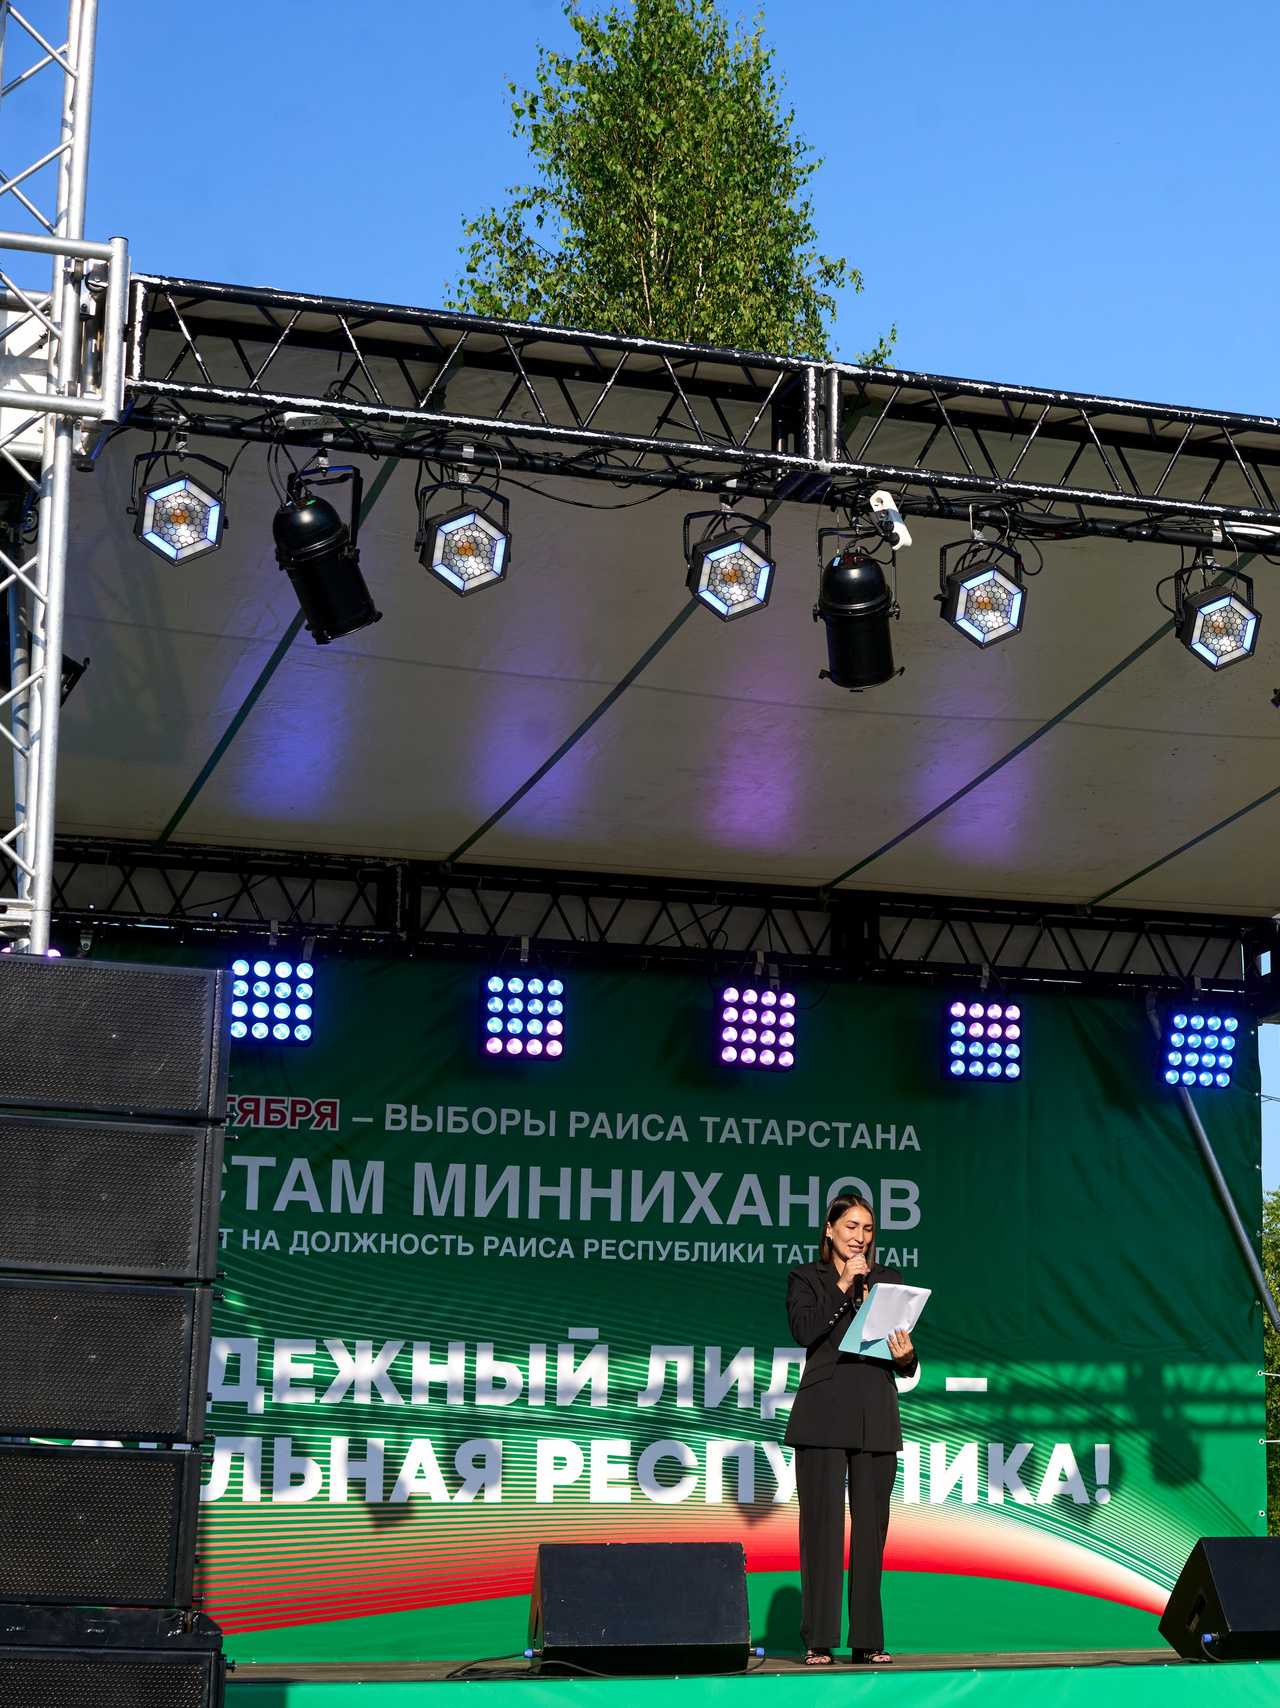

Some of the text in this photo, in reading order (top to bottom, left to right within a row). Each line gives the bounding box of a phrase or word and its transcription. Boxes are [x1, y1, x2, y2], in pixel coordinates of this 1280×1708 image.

[384, 1103, 556, 1137] ВЫБОРЫ
[569, 1111, 689, 1142] РАИСА
[700, 1116, 921, 1151] ТАТАРСТАНА
[220, 1155, 385, 1215] ТАМ
[242, 1228, 281, 1251] НА
[288, 1230, 474, 1256] ДОЛЖНОСТЬ
[483, 1235, 575, 1259] РАИСА
[583, 1238, 764, 1265] РЕСПУБЛИКИ
[772, 1243, 919, 1268] ТАТТАН
[206, 1327, 609, 1414] ДЕЖНЫЙ
[200, 1436, 1111, 1505] ЛЬНАЯ РЕСПУИКА!
